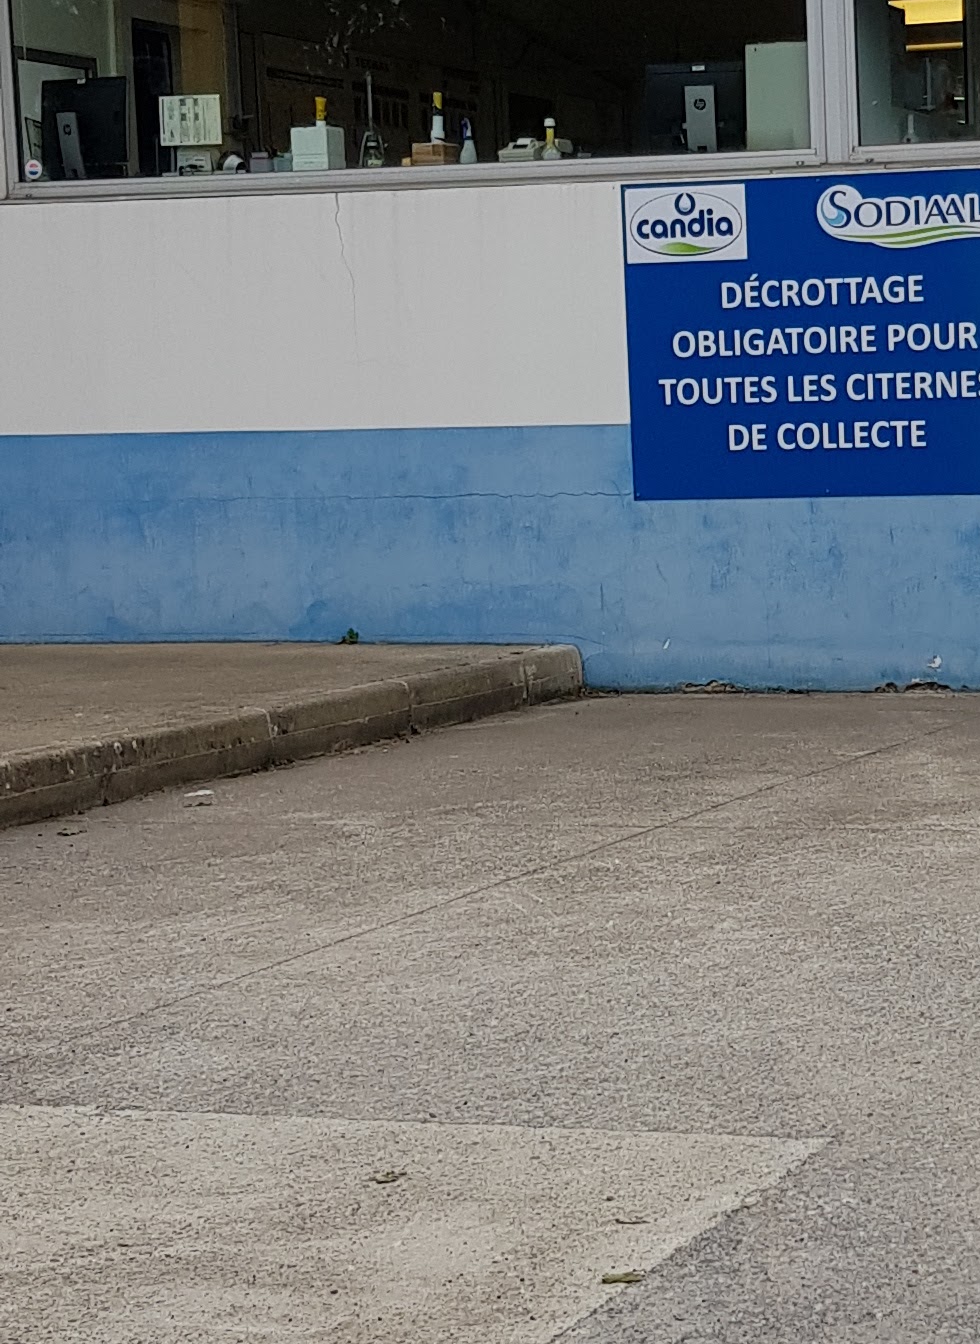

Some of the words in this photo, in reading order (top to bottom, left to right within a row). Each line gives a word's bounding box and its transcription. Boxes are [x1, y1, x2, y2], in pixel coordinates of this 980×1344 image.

[636, 209, 734, 239] candia
[721, 274, 924, 309] DÉCROTTAGE
[672, 325, 876, 358] OBLIGATOIRE
[887, 322, 978, 352] POUR
[659, 376, 777, 405] TOUTES
[787, 373, 836, 402] LES
[728, 423, 767, 451] DE
[776, 420, 927, 451] COLLECTE
